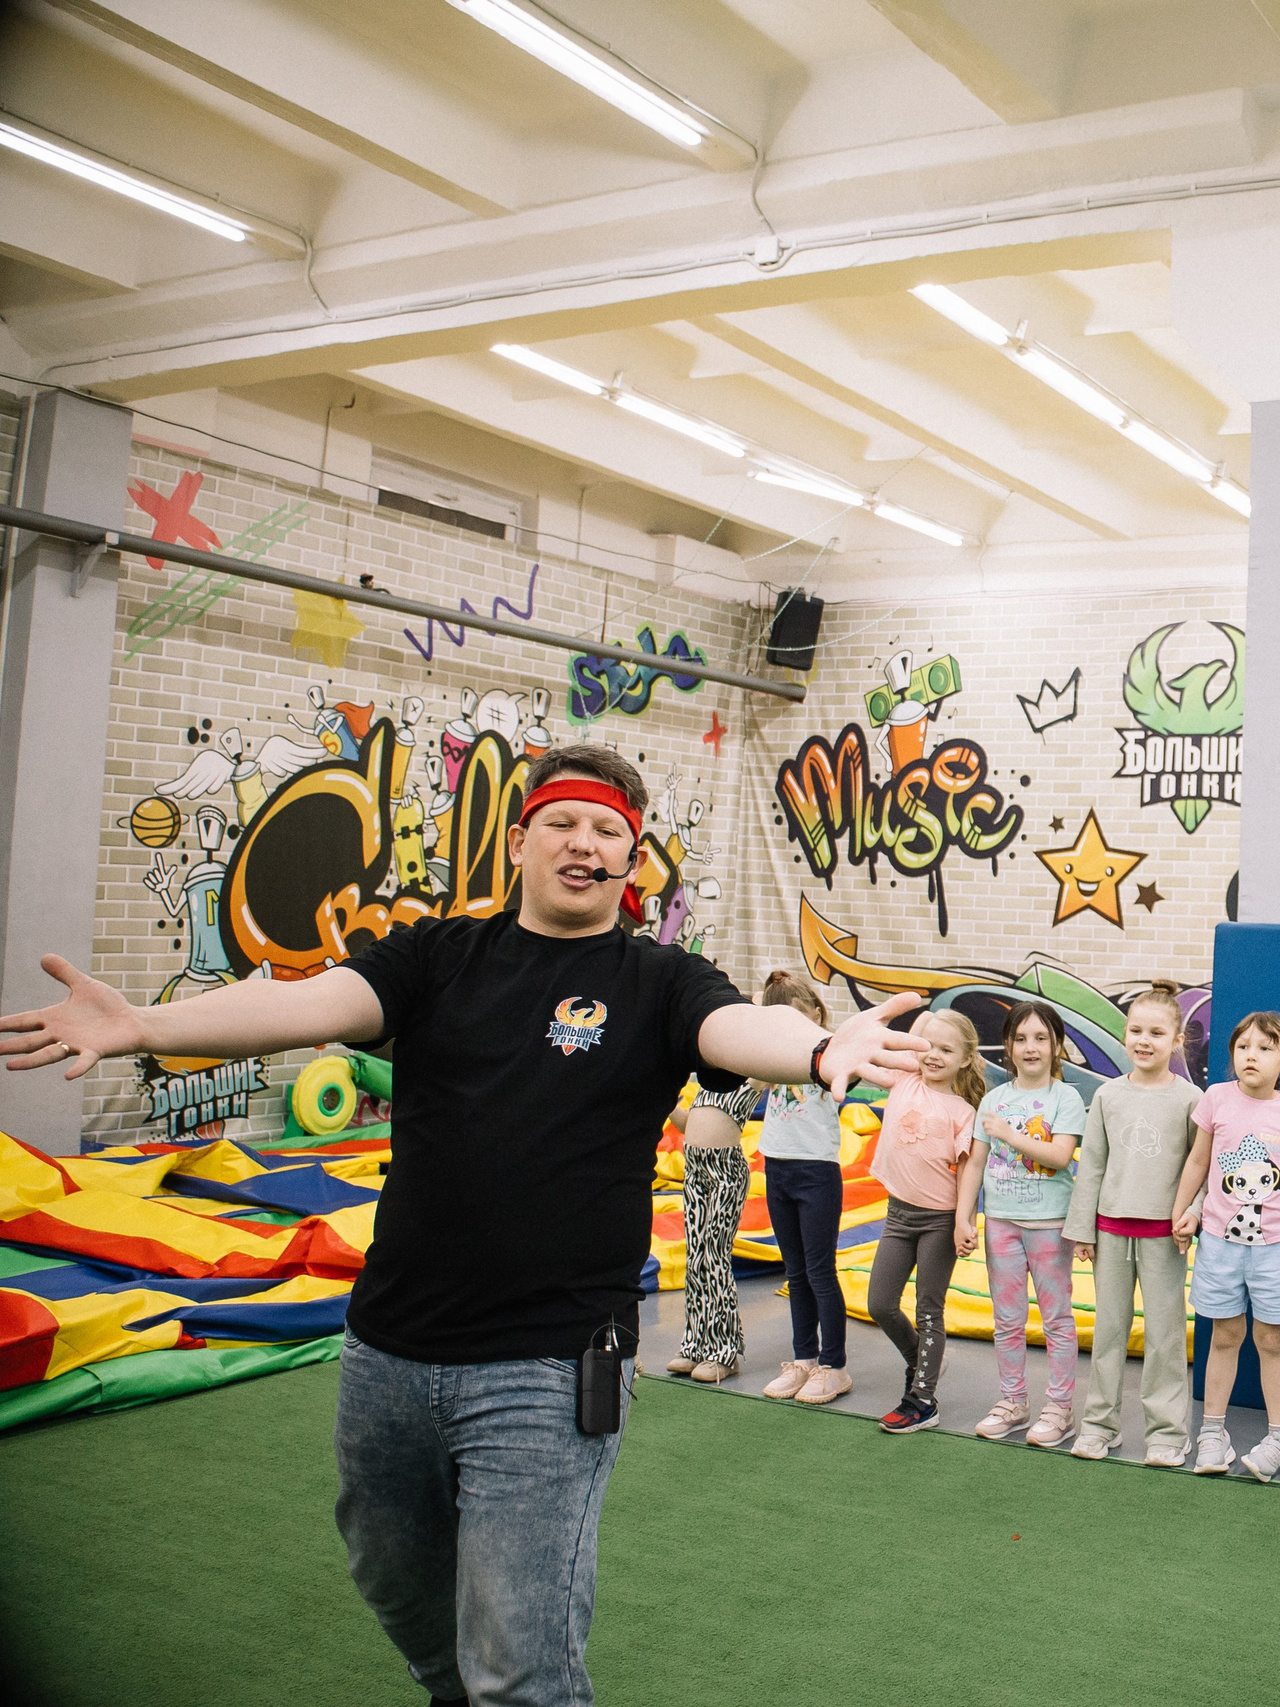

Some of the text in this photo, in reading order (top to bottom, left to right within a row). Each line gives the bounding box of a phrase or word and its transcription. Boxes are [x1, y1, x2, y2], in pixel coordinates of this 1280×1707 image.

[1119, 730, 1242, 776] БОЛЬШИ
[778, 726, 1021, 875] Music
[1142, 773, 1242, 804] ГОНКИ
[549, 1022, 603, 1042] БОЛЬШИЕ
[553, 1035, 591, 1049] ГОНКИ
[150, 1056, 265, 1119] БОЛЬШИЕ
[170, 1092, 247, 1137] ГОНКИ
